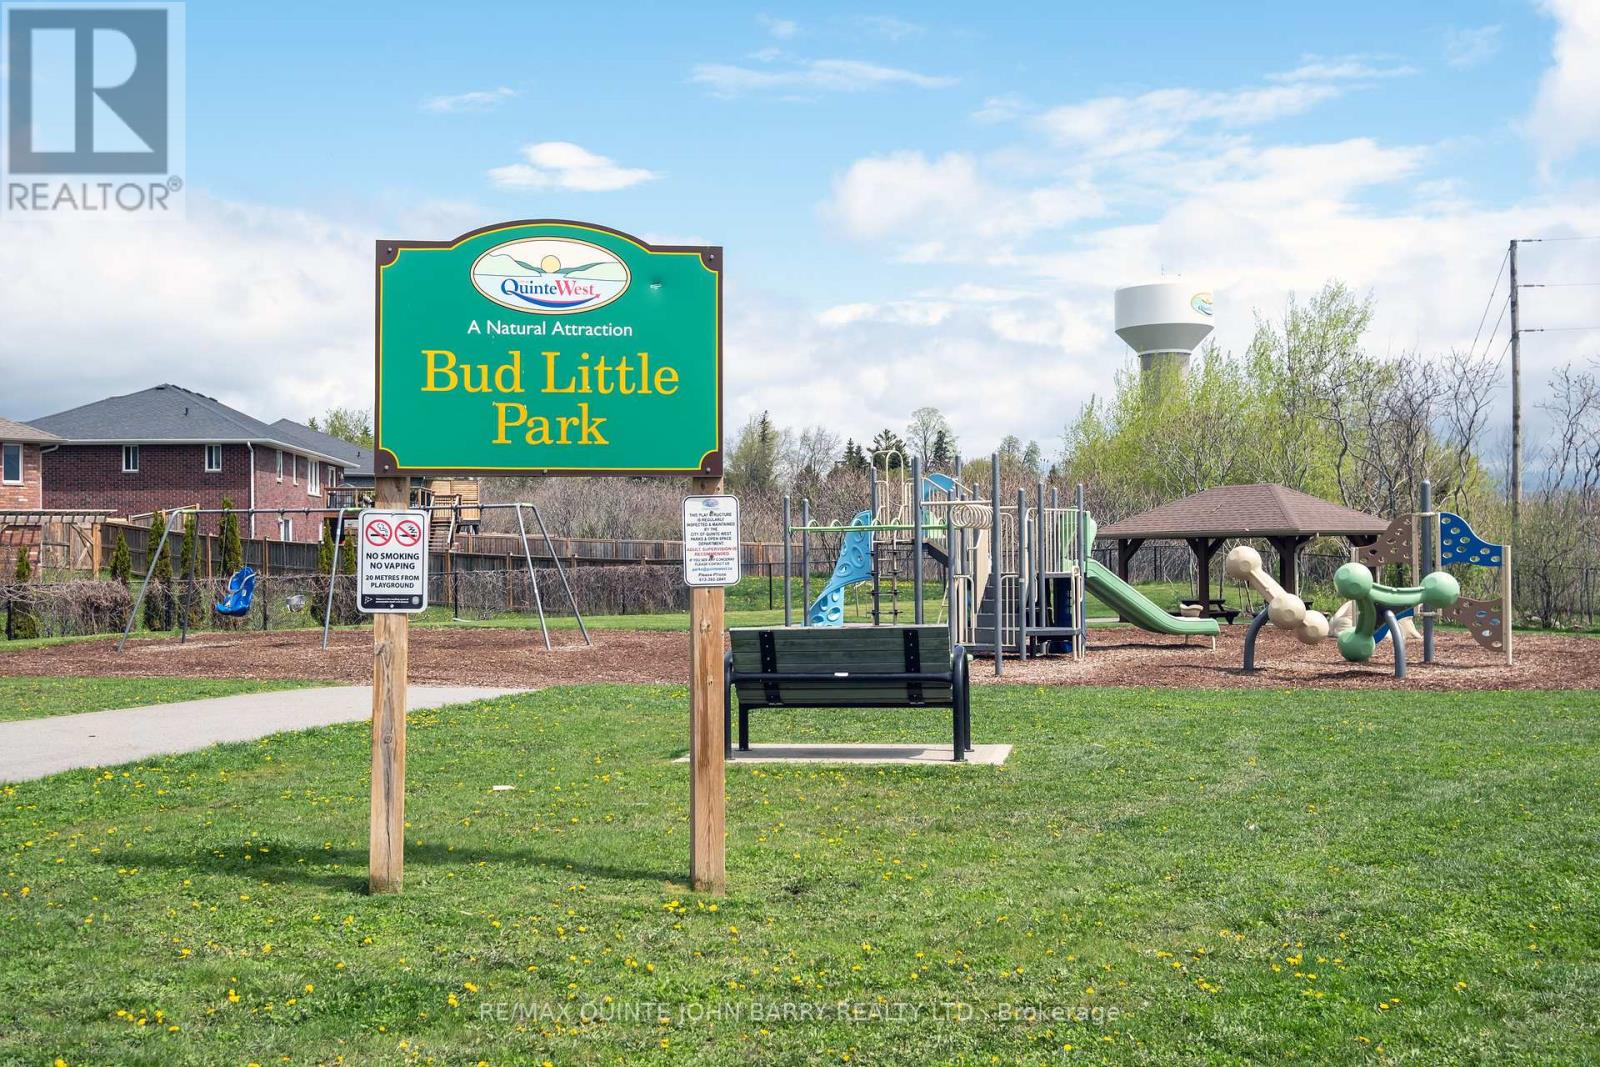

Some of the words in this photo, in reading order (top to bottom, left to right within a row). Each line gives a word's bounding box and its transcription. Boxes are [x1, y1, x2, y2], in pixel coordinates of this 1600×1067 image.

[467, 319, 481, 335] A
[486, 319, 546, 336] Natural
[551, 320, 633, 337] Attraction
[421, 349, 525, 393] Bud
[540, 351, 680, 395] Little
[491, 401, 610, 445] Park
[366, 552, 379, 560] NO
[380, 552, 420, 560] SMOKING
[384, 562, 416, 570] VAPING
